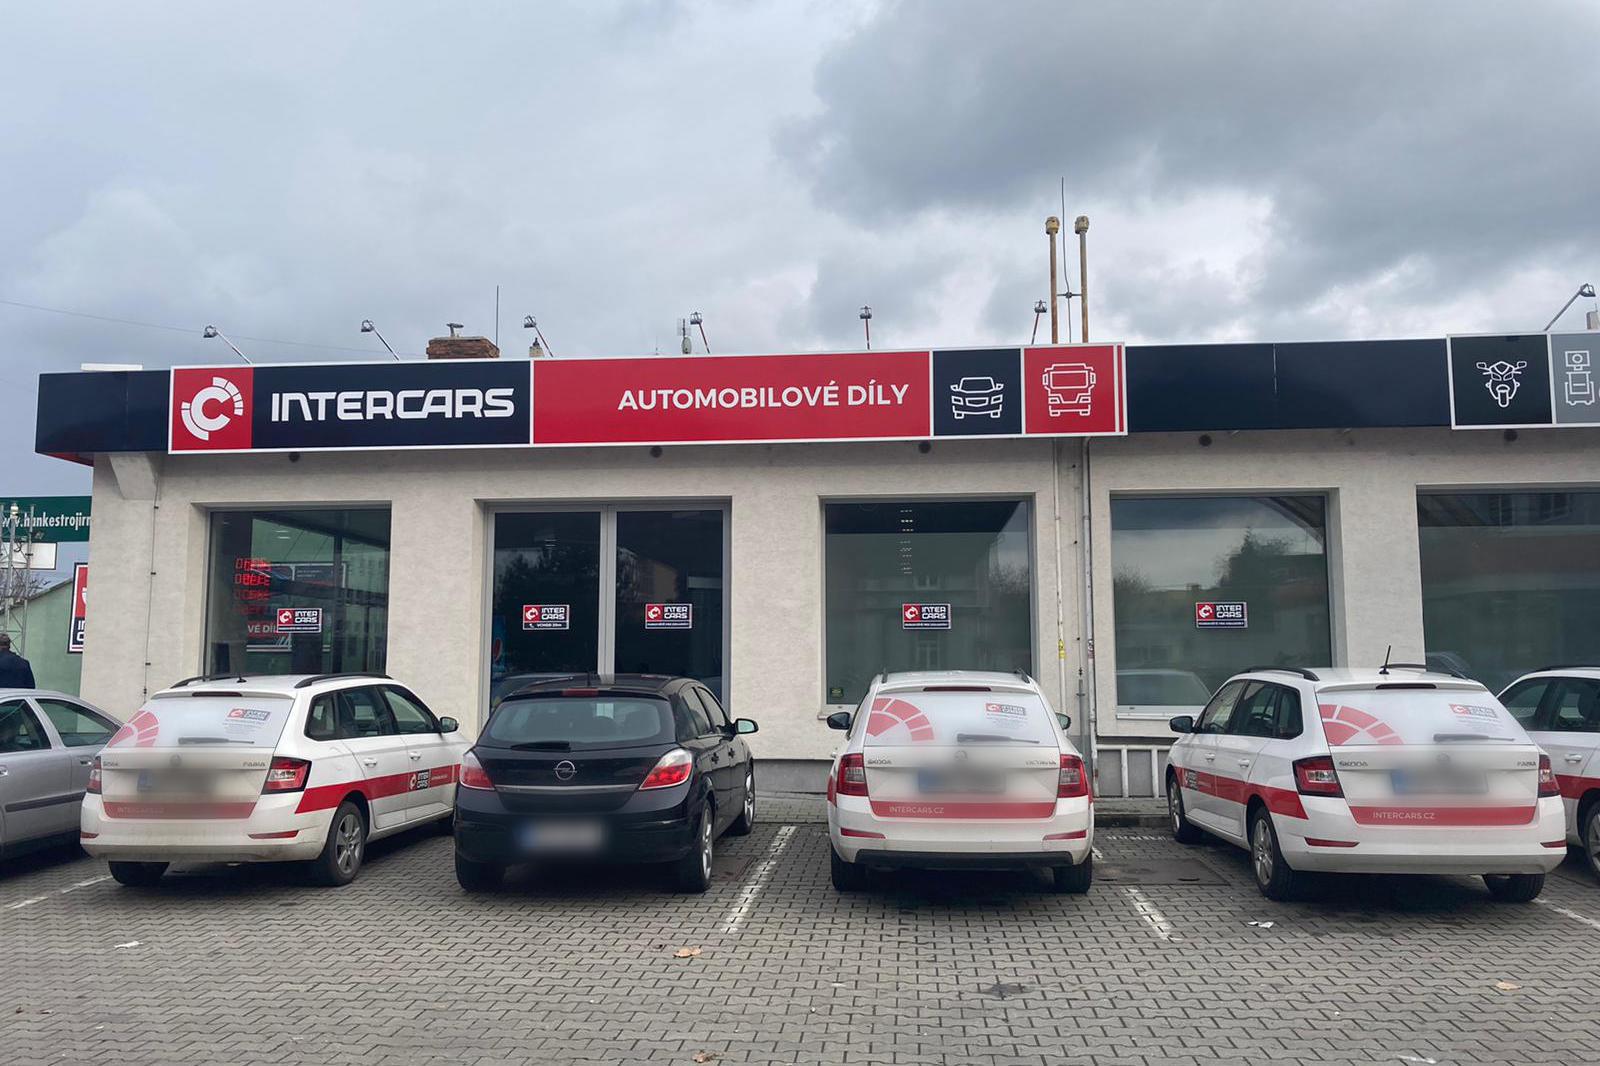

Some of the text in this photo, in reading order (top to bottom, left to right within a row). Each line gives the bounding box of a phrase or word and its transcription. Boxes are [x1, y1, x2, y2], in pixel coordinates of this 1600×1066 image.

[617, 379, 909, 410] AUTOMOBILOVÉ DÍLY
[271, 388, 514, 422] INTERCARS
[889, 806, 944, 815] INTERCARS.CZ
[1372, 812, 1435, 821] INTERCARS.CZ
